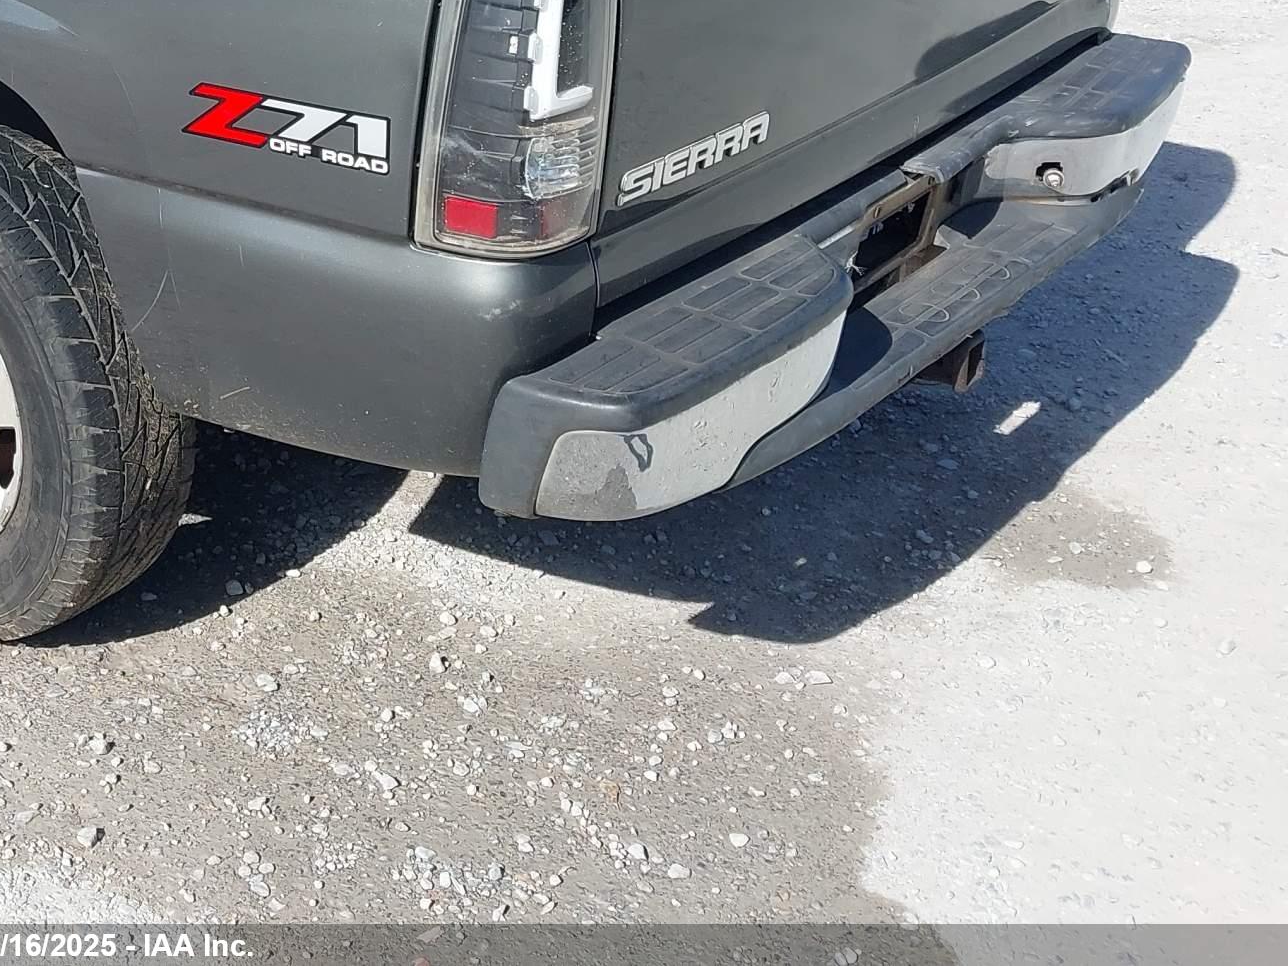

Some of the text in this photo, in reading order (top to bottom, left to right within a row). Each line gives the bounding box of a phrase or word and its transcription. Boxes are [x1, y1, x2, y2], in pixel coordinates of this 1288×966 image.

[183, 83, 390, 160] Z71
[269, 137, 389, 174] OFF ROAD
[617, 111, 770, 207] SIERRA
